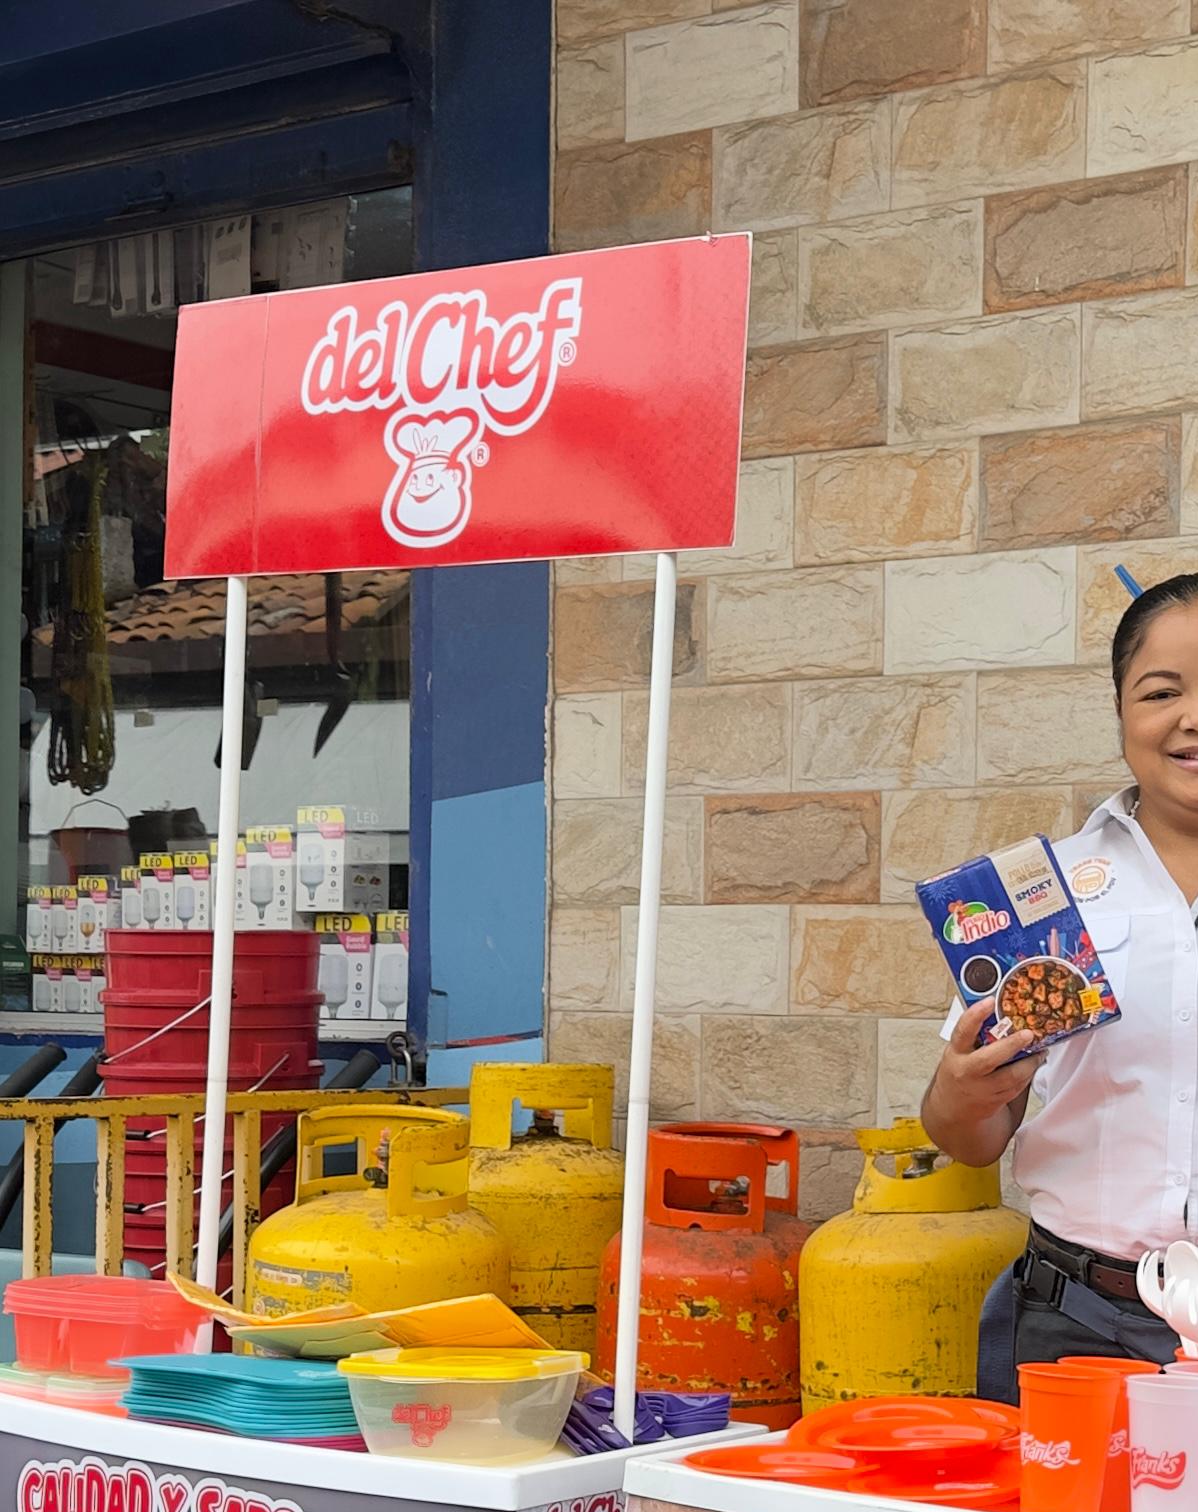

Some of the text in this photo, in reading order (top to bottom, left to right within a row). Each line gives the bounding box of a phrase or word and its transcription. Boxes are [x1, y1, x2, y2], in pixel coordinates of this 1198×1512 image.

[304, 809, 329, 822] LED
[356, 812, 379, 824] LED
[253, 831, 277, 843] LED
[144, 857, 162, 867] LED
[179, 855, 198, 866] LED
[80, 879, 99, 890] LED
[1015, 878, 1053, 902] SMOKY
[323, 916, 352, 932] LED
[961, 911, 1010, 943] Indio
[35, 956, 54, 968] LED
[65, 956, 83, 968] LED
